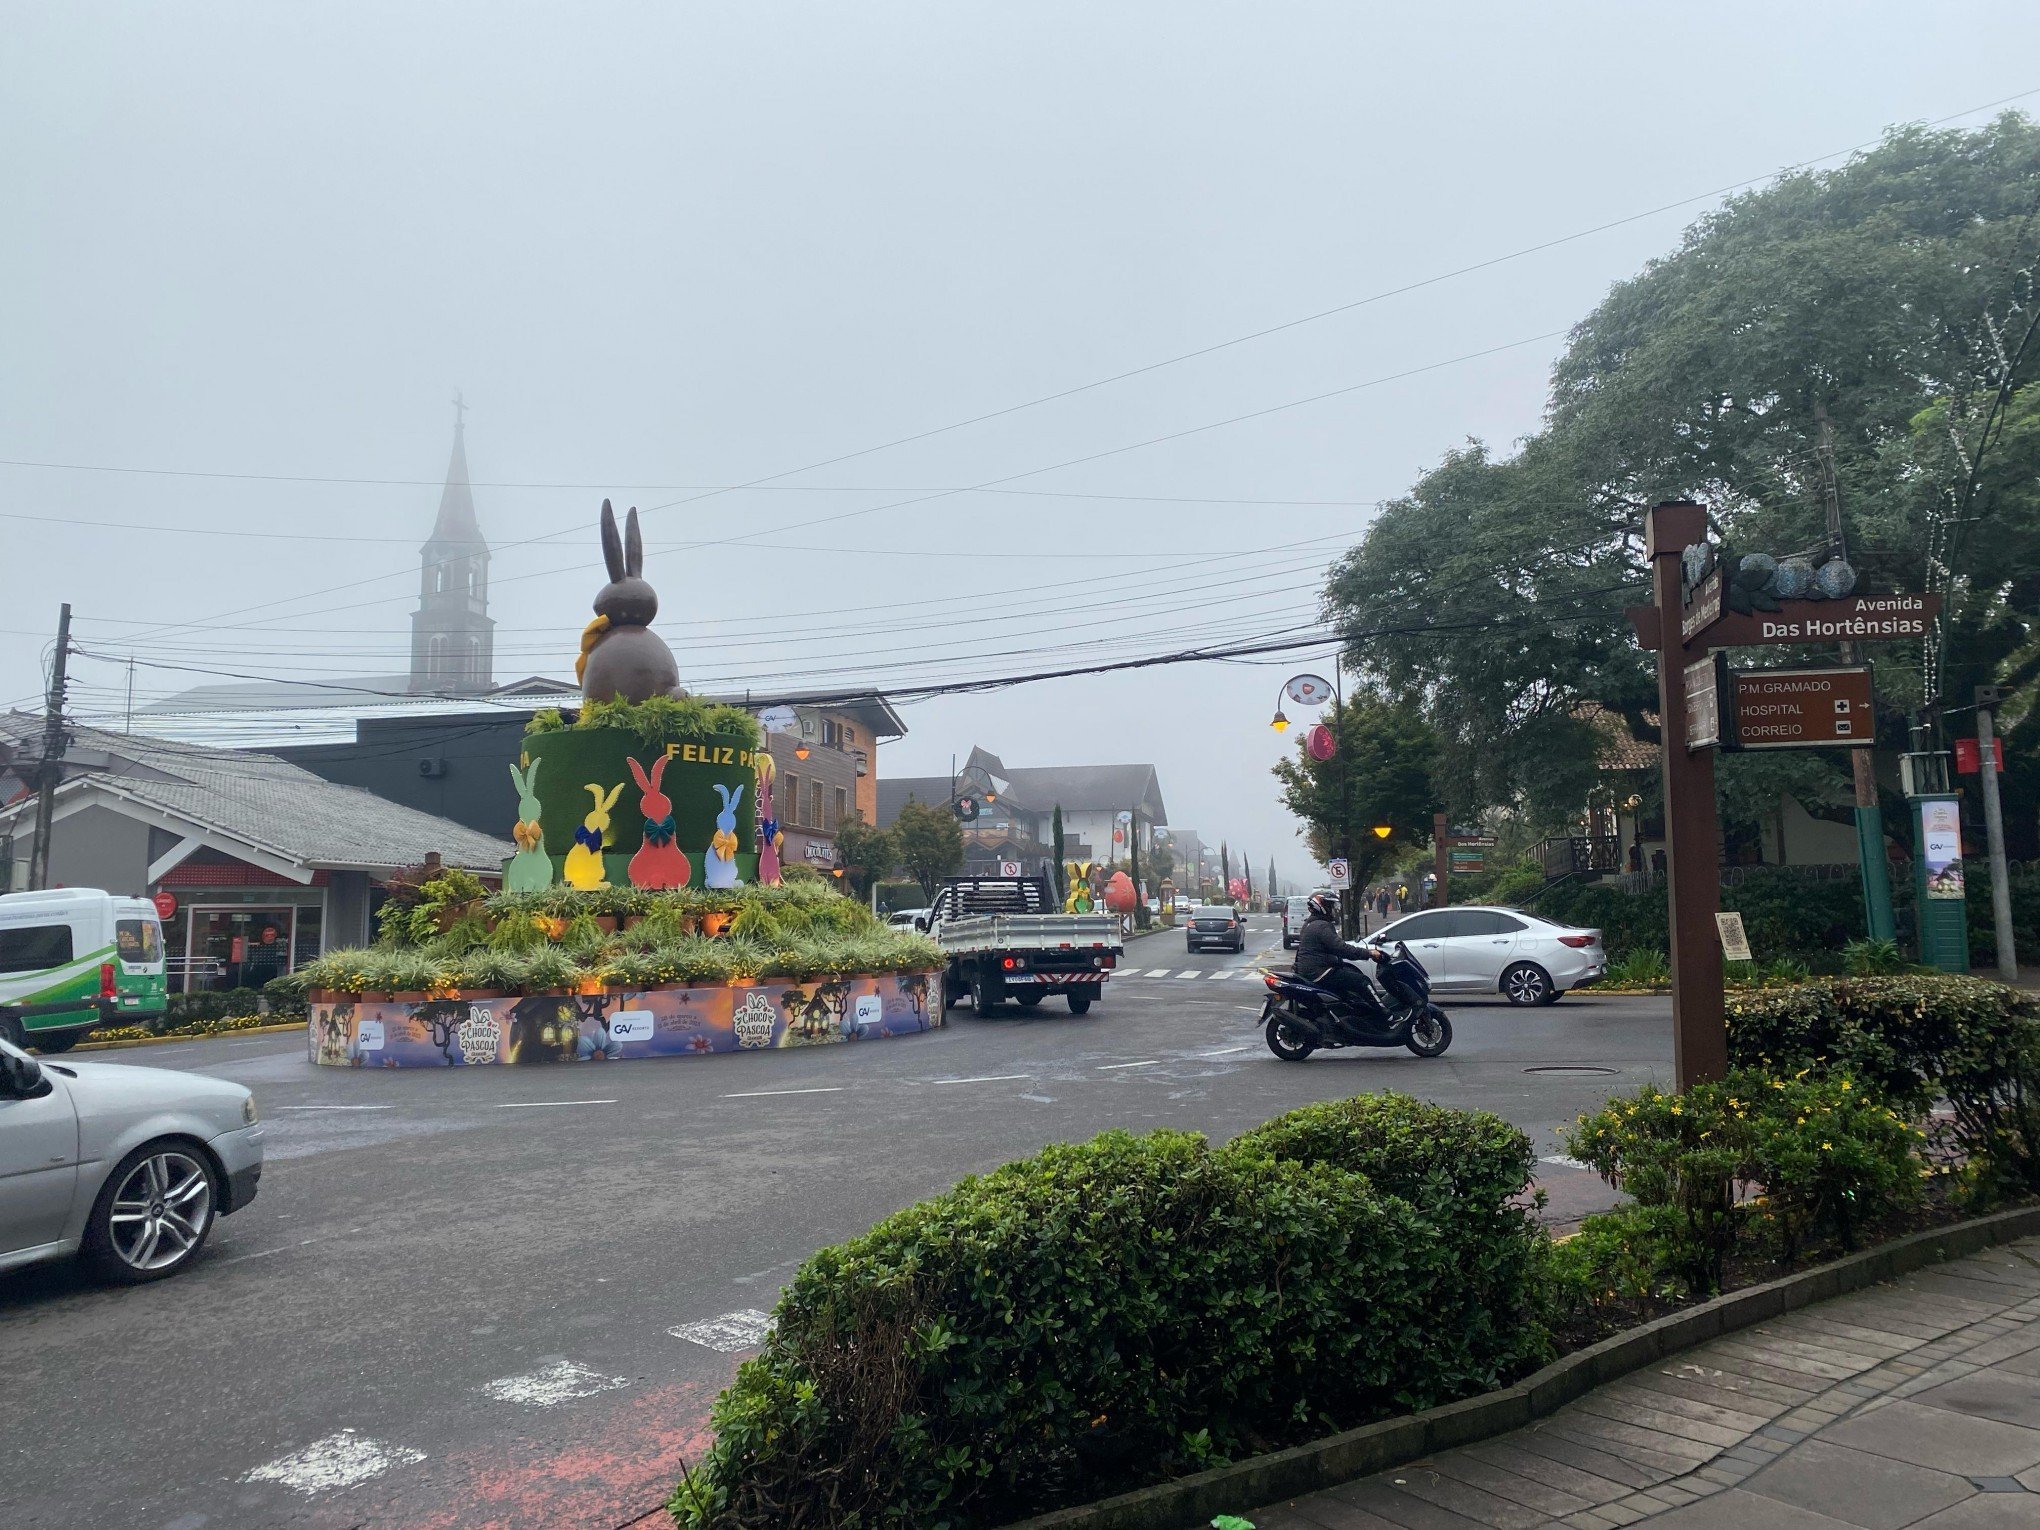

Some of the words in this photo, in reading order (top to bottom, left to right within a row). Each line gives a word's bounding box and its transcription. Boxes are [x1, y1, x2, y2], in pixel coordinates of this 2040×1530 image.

[1856, 597, 1923, 611] Avenida
[1763, 622, 1800, 638] Das
[1806, 617, 1924, 636] Hortênsias
[1740, 704, 1803, 716] HOSPITAL
[1741, 725, 1802, 737] CORREIO
[667, 743, 734, 765] FELIZ
[743, 1012, 768, 1024] CHOCO
[860, 1007, 870, 1017] GAV
[467, 1028, 492, 1039] CHOCO
[614, 1024, 632, 1034] GAV
[360, 1033, 371, 1042] GAV
